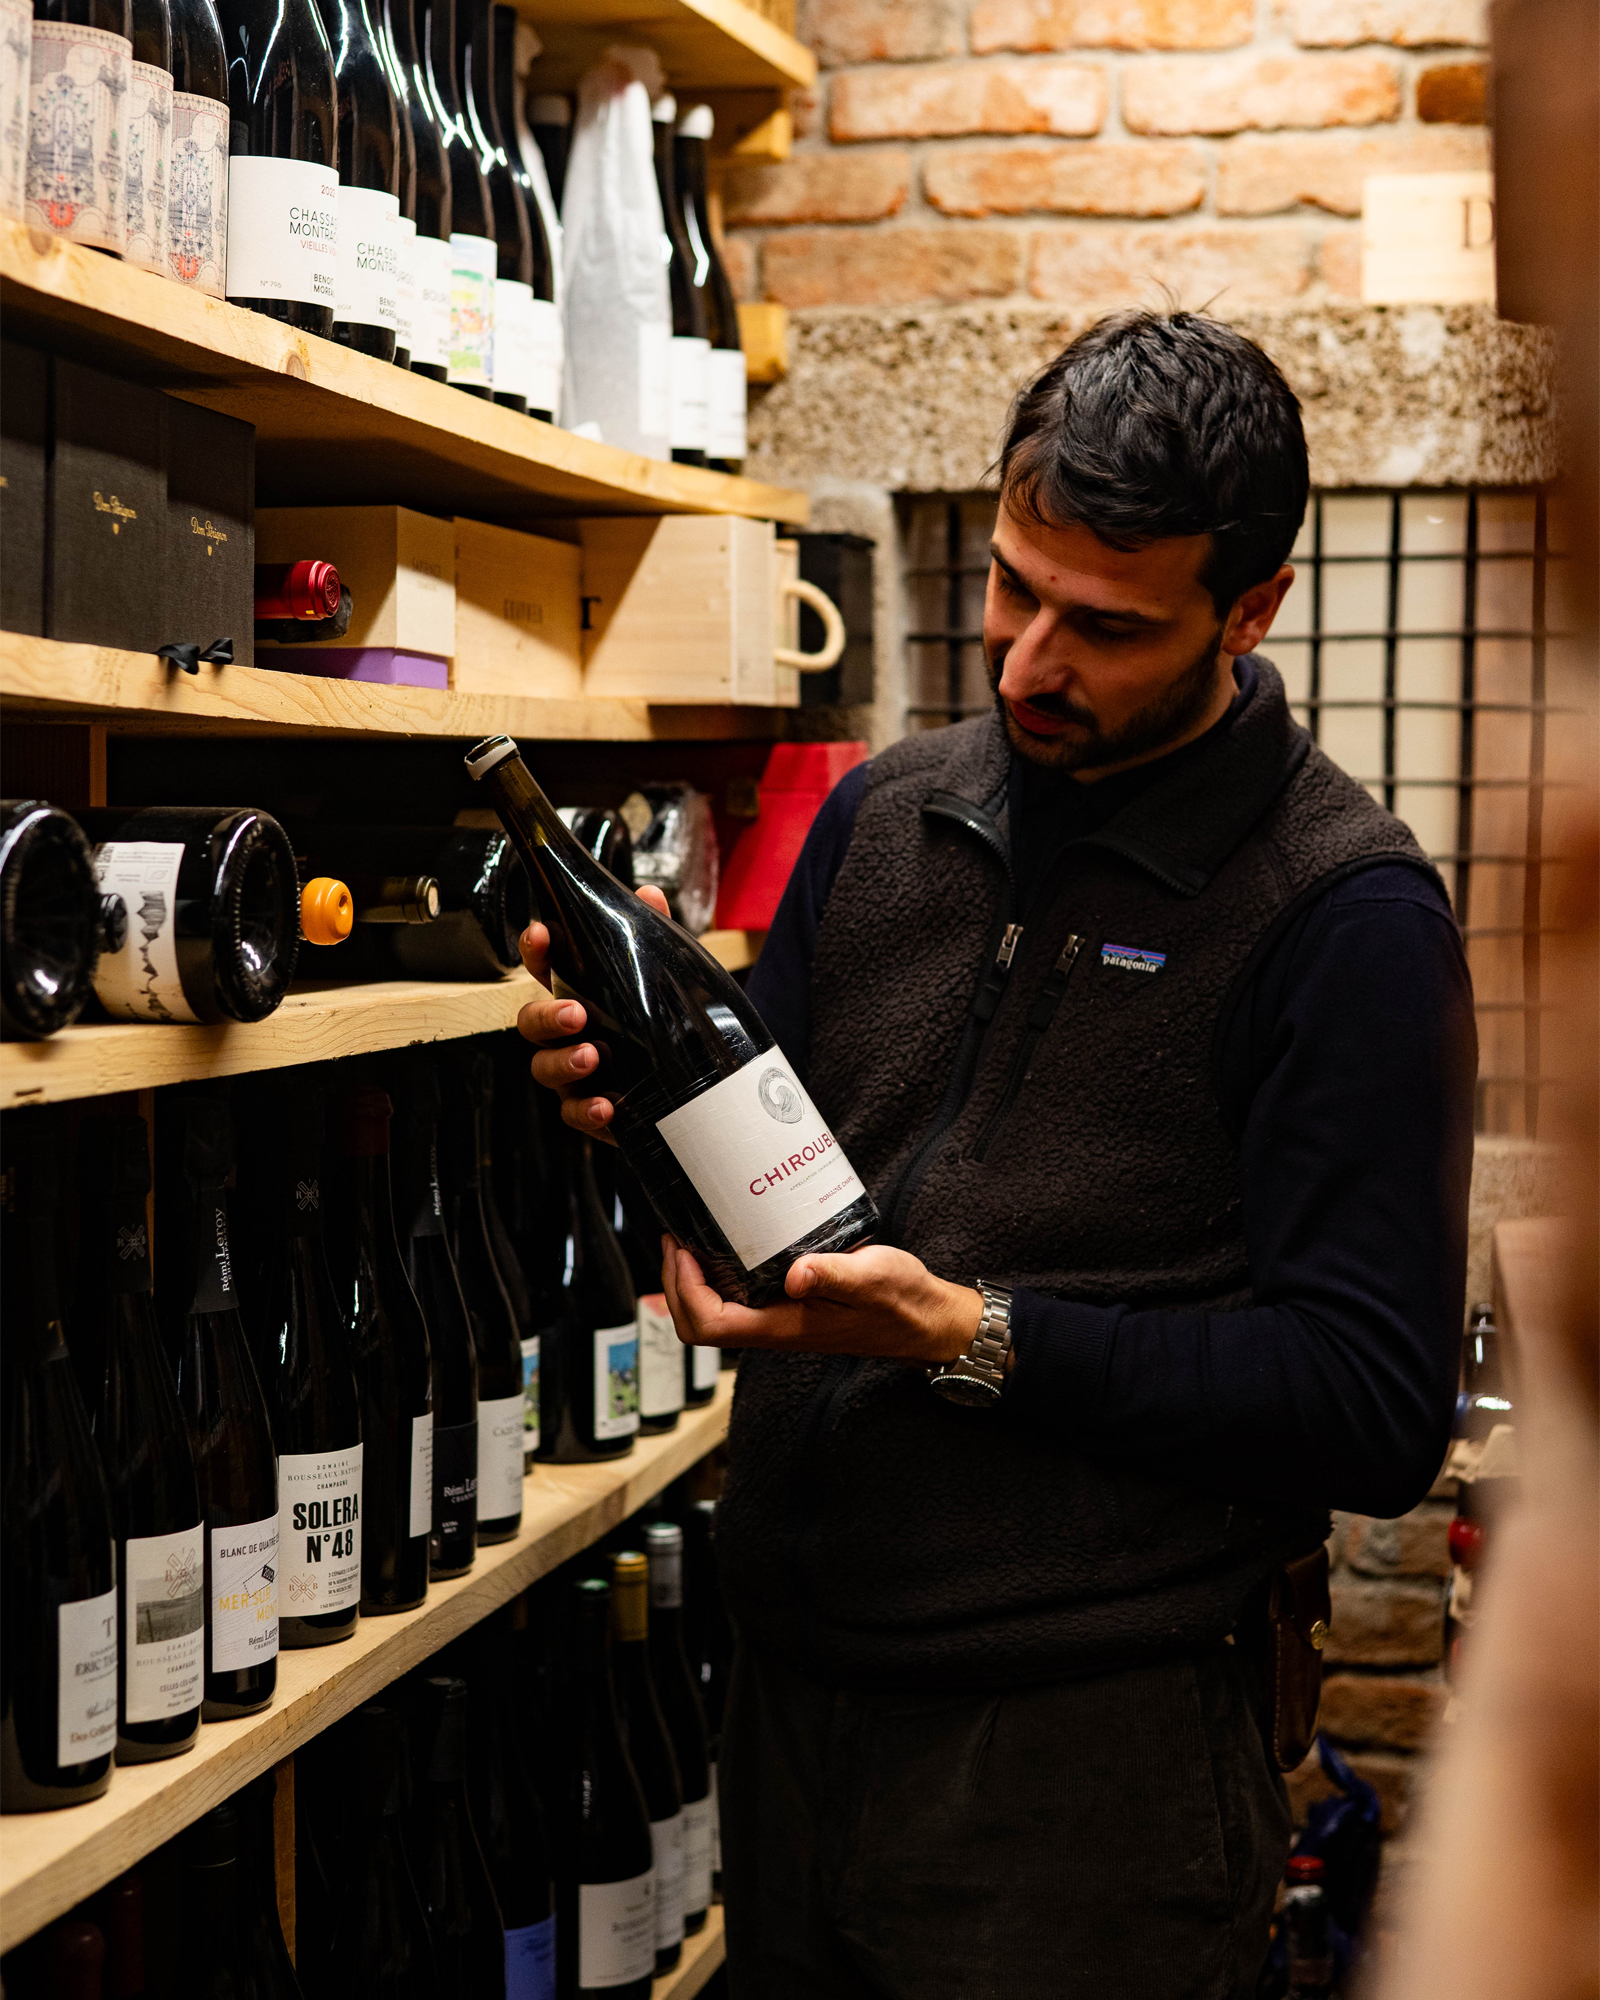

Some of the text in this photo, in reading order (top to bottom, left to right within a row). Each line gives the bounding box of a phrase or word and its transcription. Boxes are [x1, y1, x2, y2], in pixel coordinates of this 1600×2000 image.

[301, 239, 328, 254] VIEILLES
[190, 516, 206, 536] Dom
[1102, 955, 1157, 973] patagonia
[818, 1184, 842, 1204] DOMAINE
[215, 1207, 230, 1291] Rémi Leroy
[317, 1460, 349, 1471] DOMAINE
[317, 1479, 349, 1490] CHAMPAGNE
[293, 1492, 359, 1531] SOLERA
[220, 1546, 247, 1559] BLANC
[248, 1543, 258, 1554] DE
[219, 1586, 272, 1612] MER SUR
[248, 1635, 264, 1646] Rémi
[167, 1658, 196, 1673] CHAMPAGNE
